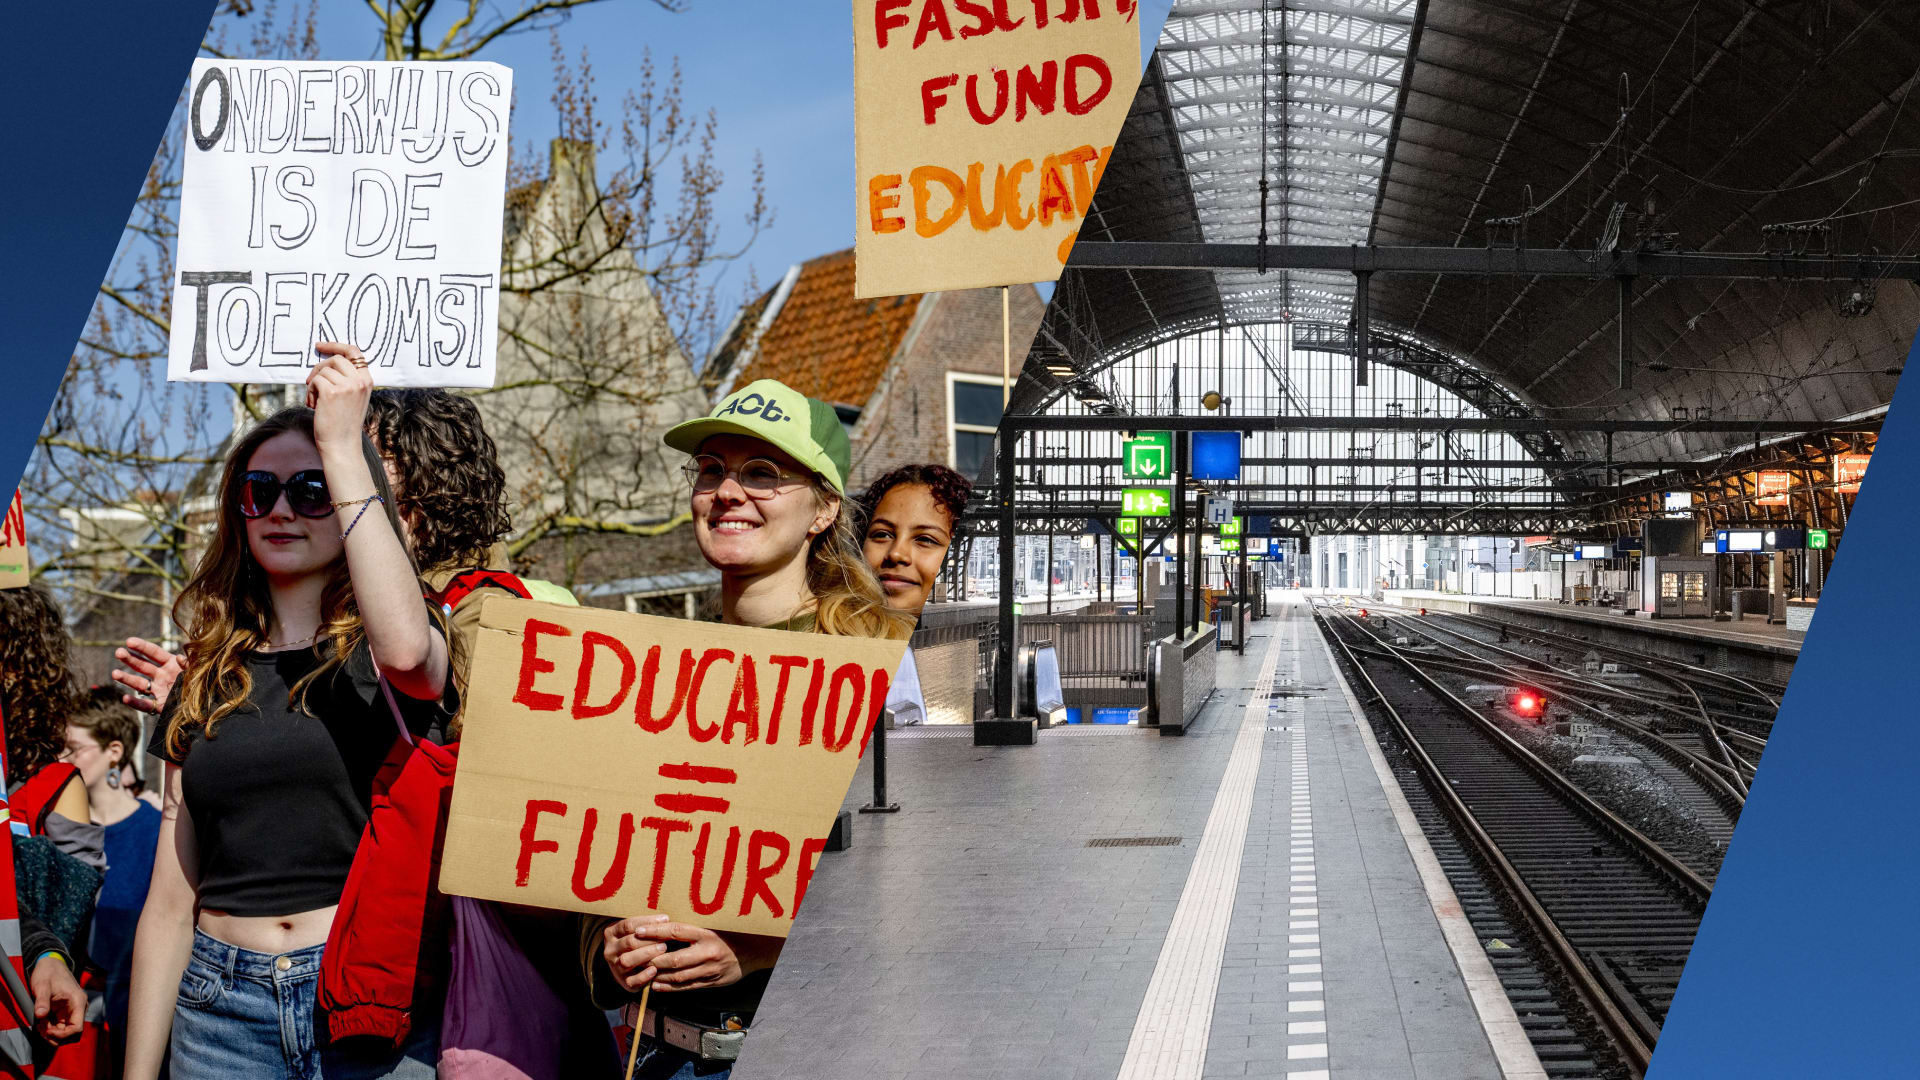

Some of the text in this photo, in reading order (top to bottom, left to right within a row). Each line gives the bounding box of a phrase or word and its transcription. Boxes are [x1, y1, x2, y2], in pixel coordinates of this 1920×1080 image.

[191, 66, 500, 167] ONDERWIJS
[921, 53, 1112, 125] FUND
[248, 165, 443, 260] IS DE
[181, 270, 493, 372] TOEKOMST
[1215, 508, 1227, 522] H
[1306, 522, 1318, 536] V
